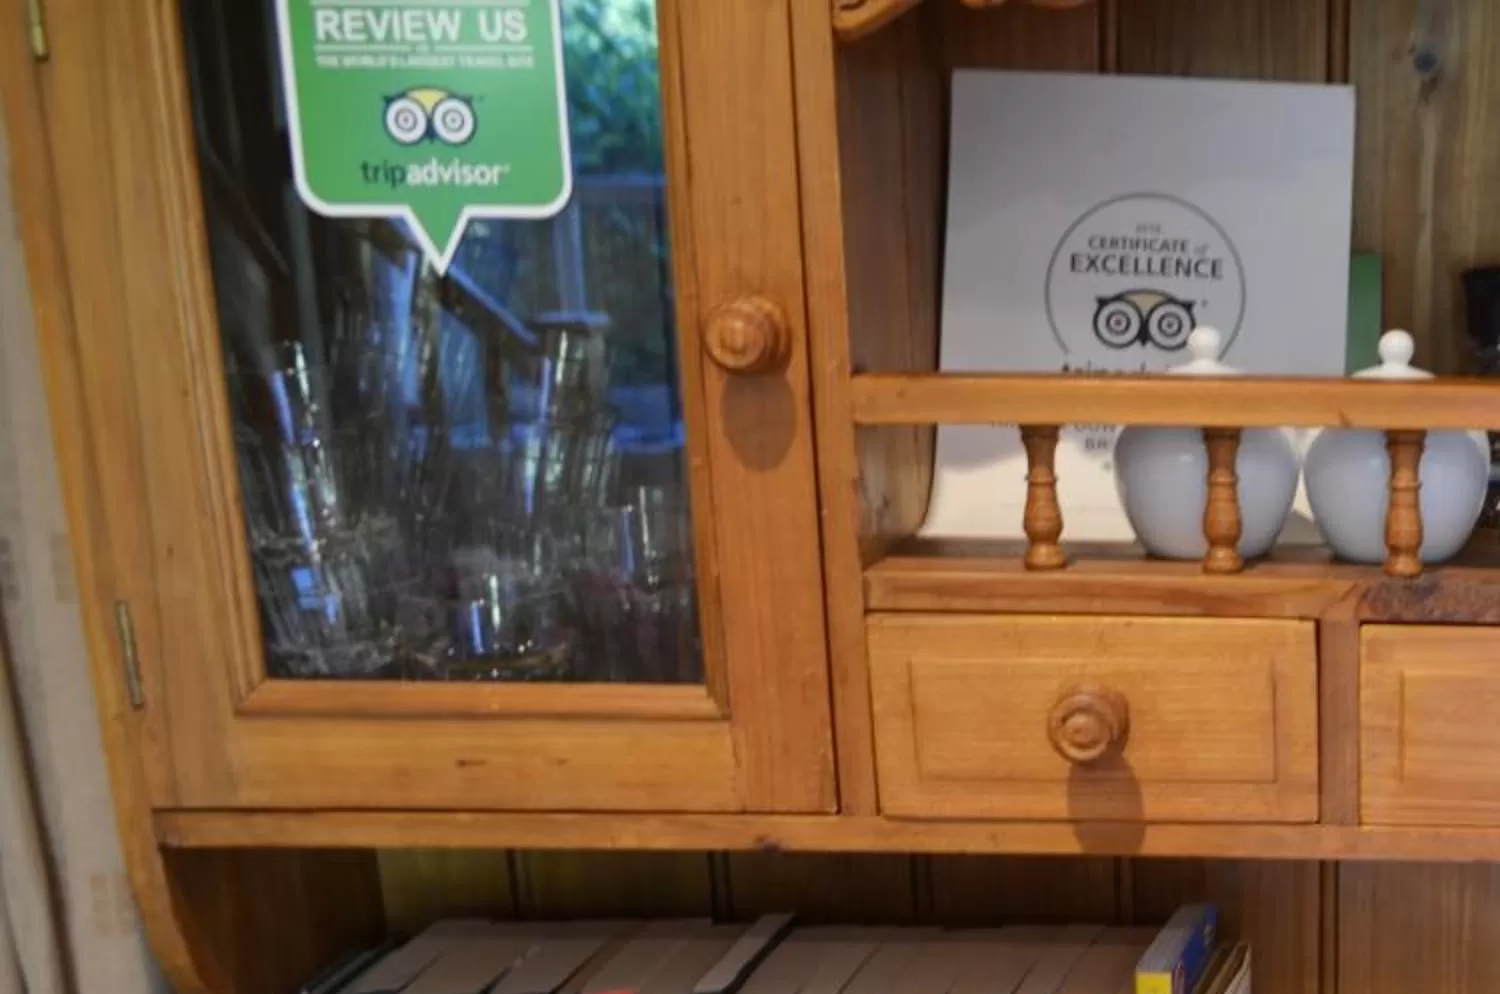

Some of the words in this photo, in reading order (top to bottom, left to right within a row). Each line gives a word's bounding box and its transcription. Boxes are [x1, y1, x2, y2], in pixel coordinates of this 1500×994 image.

[314, 8, 461, 42] REVIEW
[478, 9, 528, 42] US
[360, 156, 504, 189] tripadvisor
[1087, 234, 1188, 254] CERTIFICATE
[1070, 252, 1224, 280] EXCELLENCE
